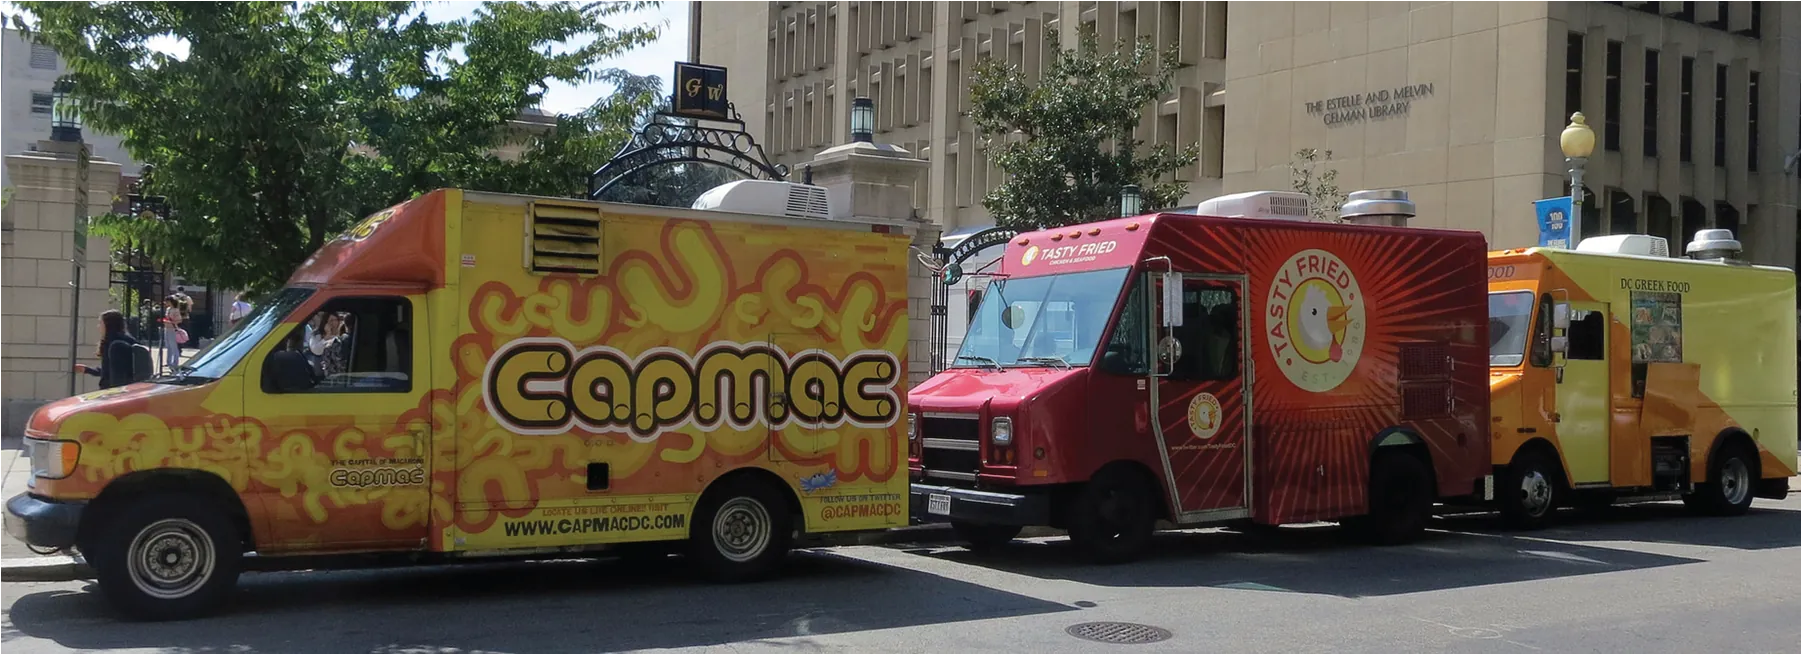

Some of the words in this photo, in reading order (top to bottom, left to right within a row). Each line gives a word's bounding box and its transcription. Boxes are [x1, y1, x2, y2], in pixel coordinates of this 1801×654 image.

[685, 78, 702, 97] G
[707, 84, 724, 101] W
[1305, 100, 1323, 113] THE
[1326, 94, 1361, 110] ESTELLE
[1365, 89, 1389, 104] AND
[1394, 83, 1433, 100] MELVIN
[1369, 101, 1410, 118] LIBRARY
[1041, 246, 1078, 260] TASTY
[1078, 241, 1116, 256] FRIED
[1488, 265, 1515, 278] OOD
[1620, 278, 1633, 289] DC
[1634, 279, 1665, 291] GREEK
[1666, 281, 1690, 293] FOOD
[1270, 269, 1293, 358] TASTY
[1296, 254, 1350, 290] FRIED
[821, 495, 844, 503] FOLLOW
[859, 494, 869, 502] ON
[871, 493, 900, 501] TWITTER
[543, 507, 572, 517] LOCATE
[574, 506, 588, 515] US
[648, 503, 668, 512] VISIT
[821, 503, 901, 521] @CAPMACDC
[505, 514, 685, 536] WWW.CAPMACDC.COM
